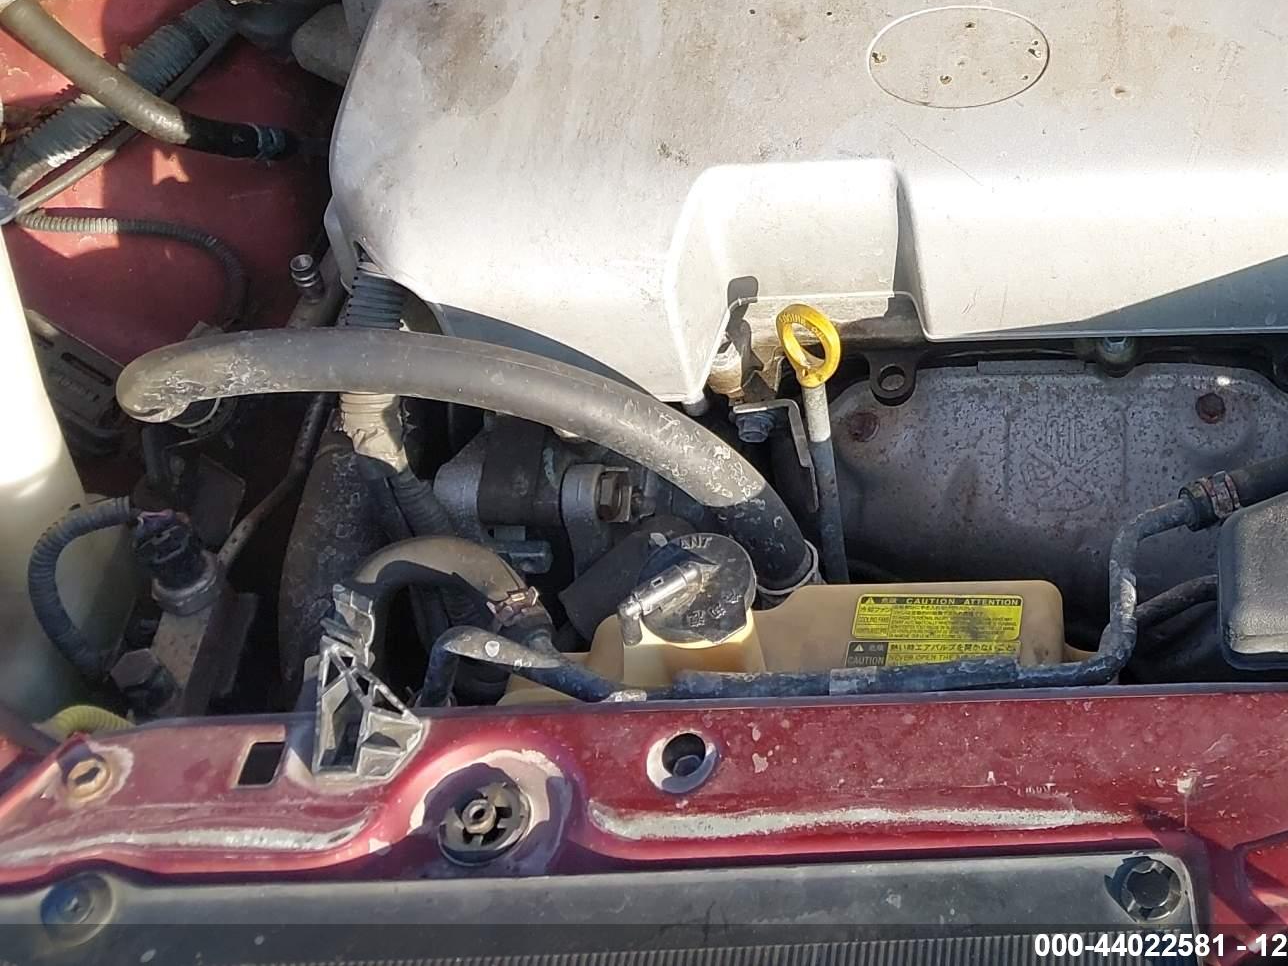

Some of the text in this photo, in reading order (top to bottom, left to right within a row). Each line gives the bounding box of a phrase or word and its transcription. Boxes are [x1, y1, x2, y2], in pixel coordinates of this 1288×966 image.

[906, 598, 956, 606] CAUTION
[963, 598, 1019, 606] ATTENTION
[848, 656, 885, 666] CAUTION
